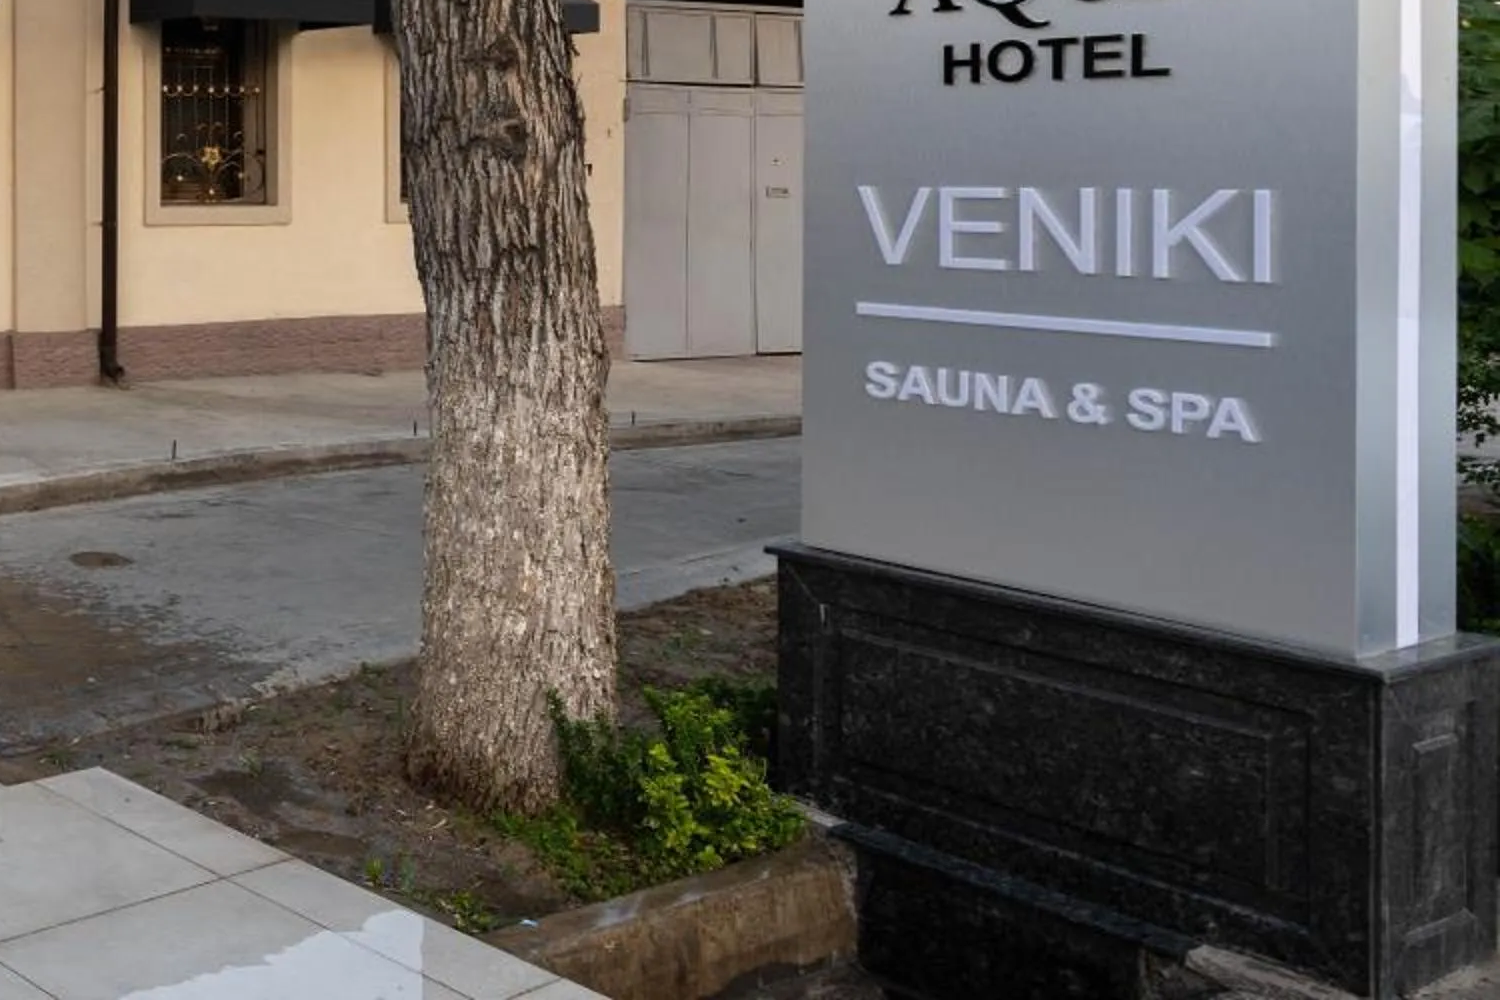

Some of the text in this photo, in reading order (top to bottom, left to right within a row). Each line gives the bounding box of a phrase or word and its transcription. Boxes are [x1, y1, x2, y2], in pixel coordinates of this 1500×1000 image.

[942, 33, 1171, 85] HOTEL
[856, 185, 1280, 283] VENIKI
[865, 362, 1263, 443] SAUNA & SPA
